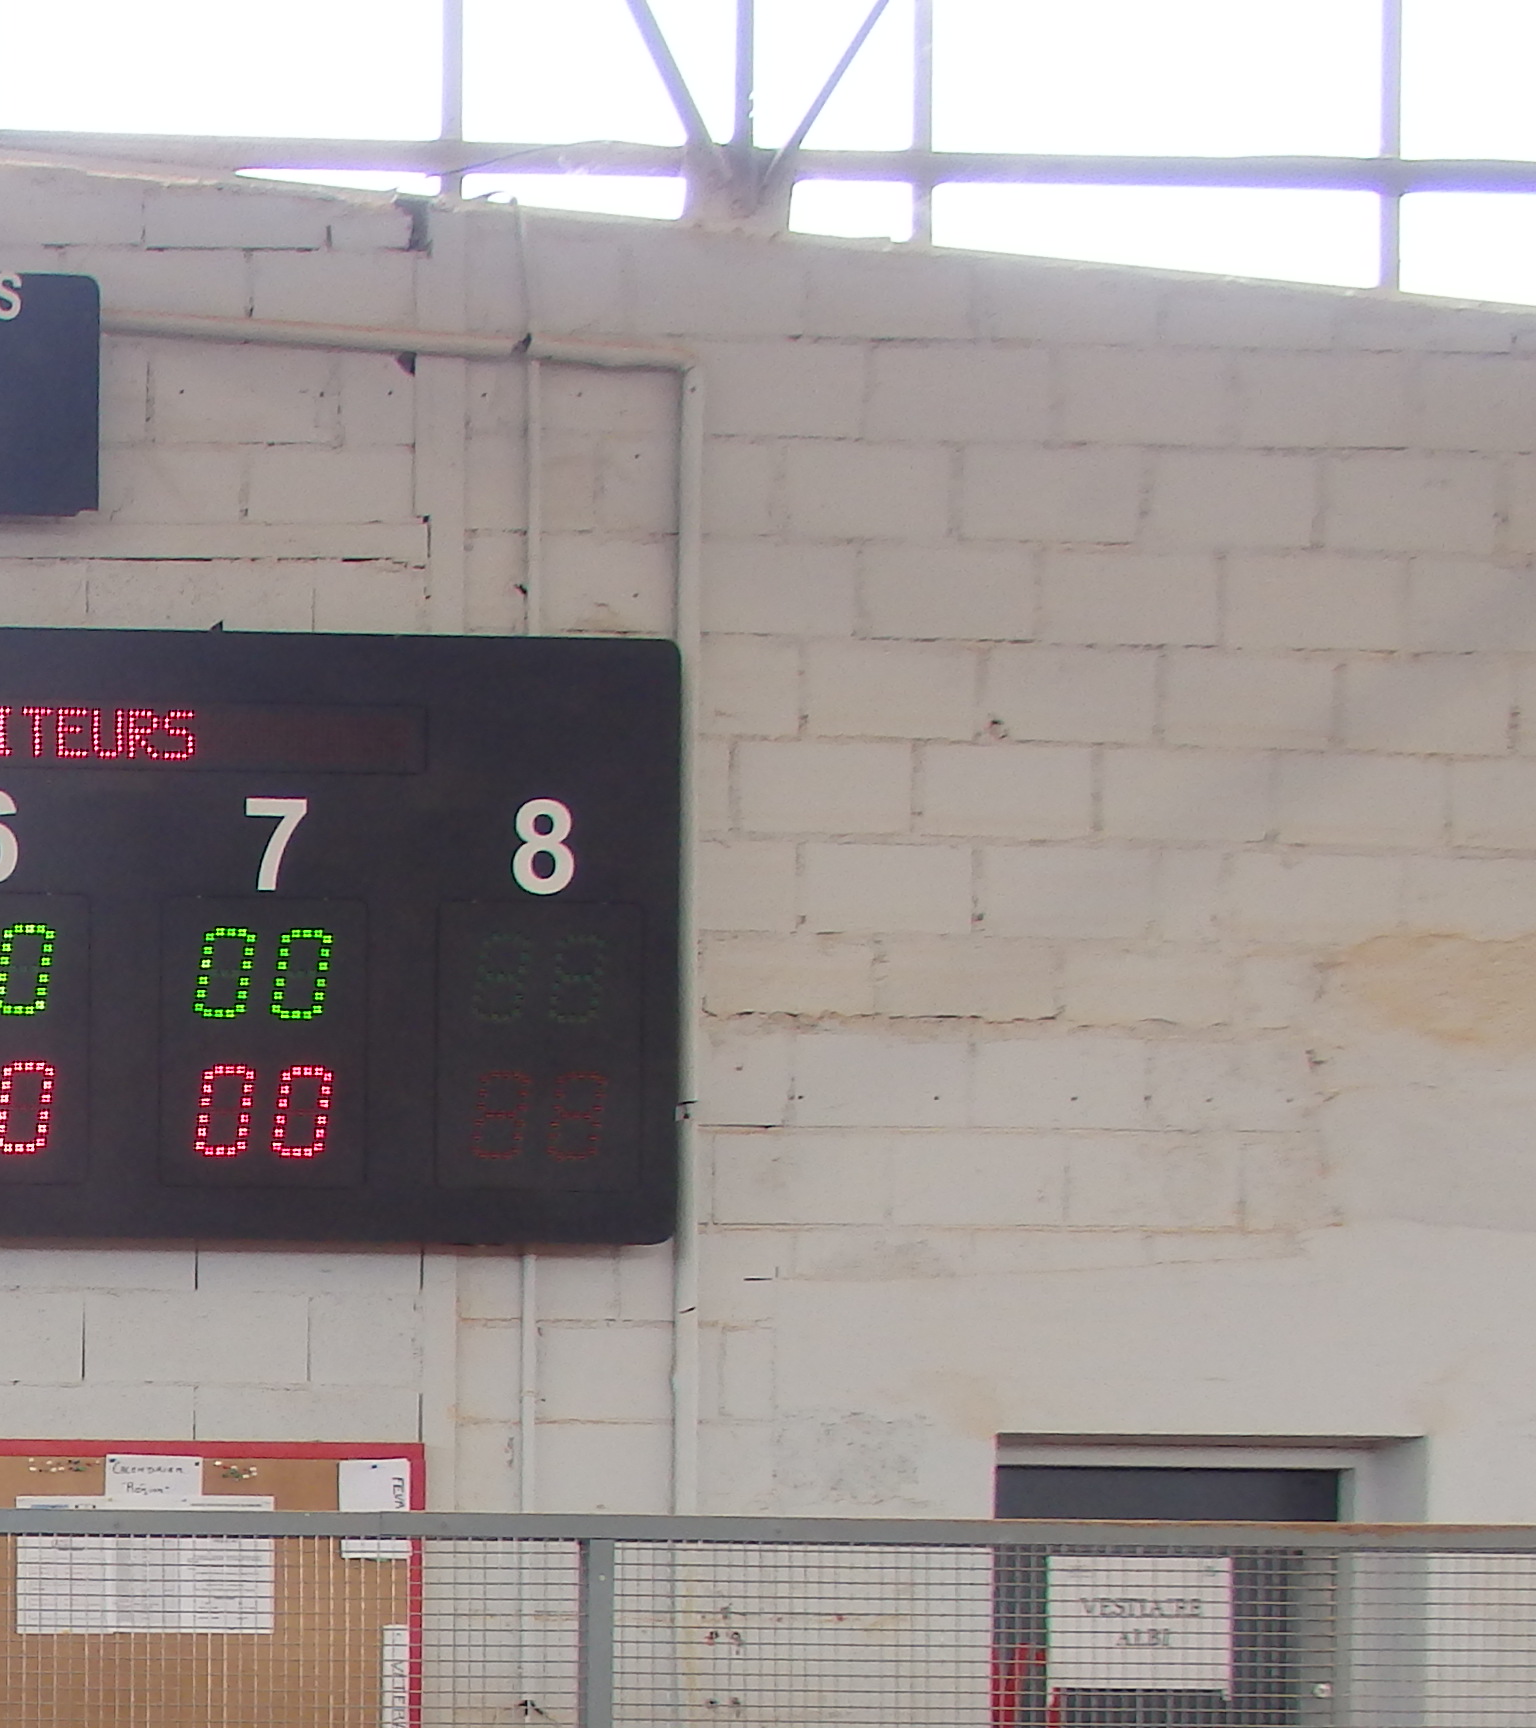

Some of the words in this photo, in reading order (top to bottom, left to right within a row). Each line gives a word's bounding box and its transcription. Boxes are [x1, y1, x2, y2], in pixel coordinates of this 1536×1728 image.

[244, 797, 309, 892] 7
[511, 798, 576, 895] 8
[193, 925, 334, 1021] 00
[193, 1063, 335, 1159] 00
